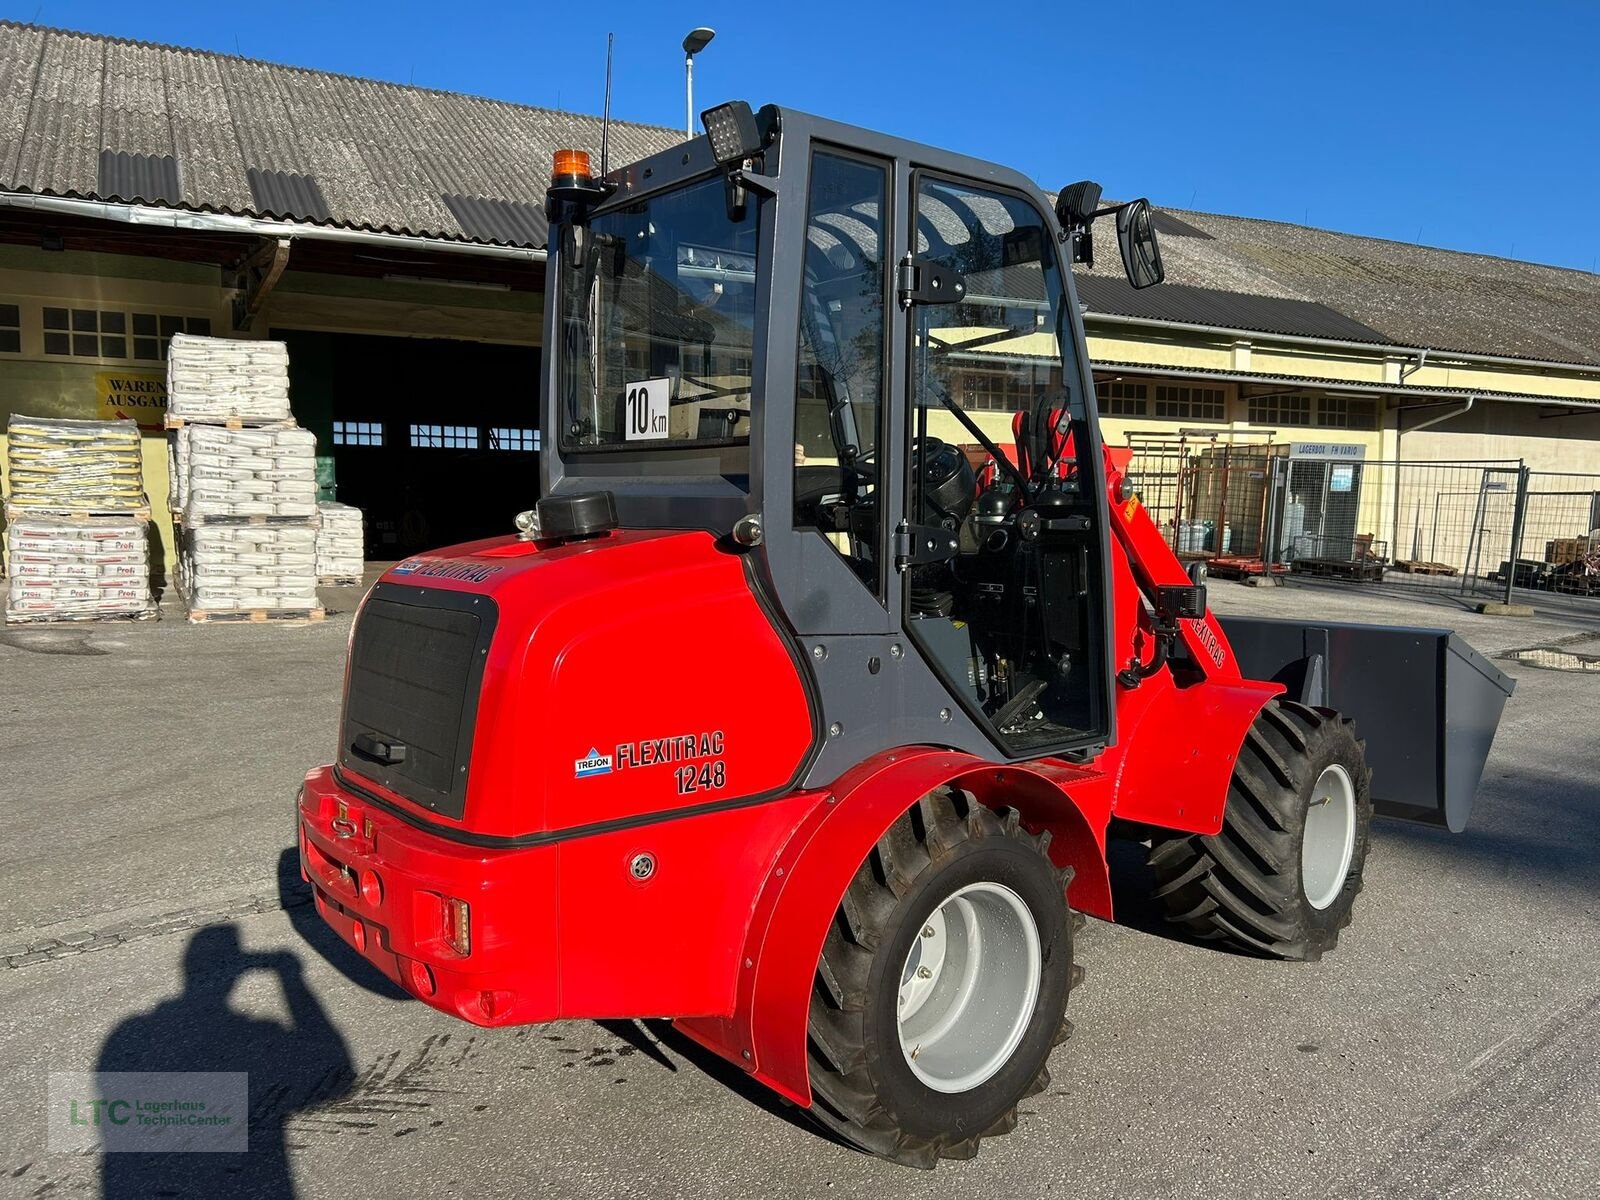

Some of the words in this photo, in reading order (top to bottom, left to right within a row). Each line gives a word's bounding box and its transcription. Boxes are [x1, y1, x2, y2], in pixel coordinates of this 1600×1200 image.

[105, 394, 168, 408] AUSGAB
[628, 387, 648, 434] 10
[652, 409, 667, 433] km
[1299, 445, 1325, 454] LAGERBOX
[1340, 446, 1358, 456] VARIO
[1190, 619, 1226, 669] LEXITRAC
[577, 757, 609, 770] TREJON
[616, 731, 724, 770] FLEXITRAC
[674, 761, 726, 795] 1248
